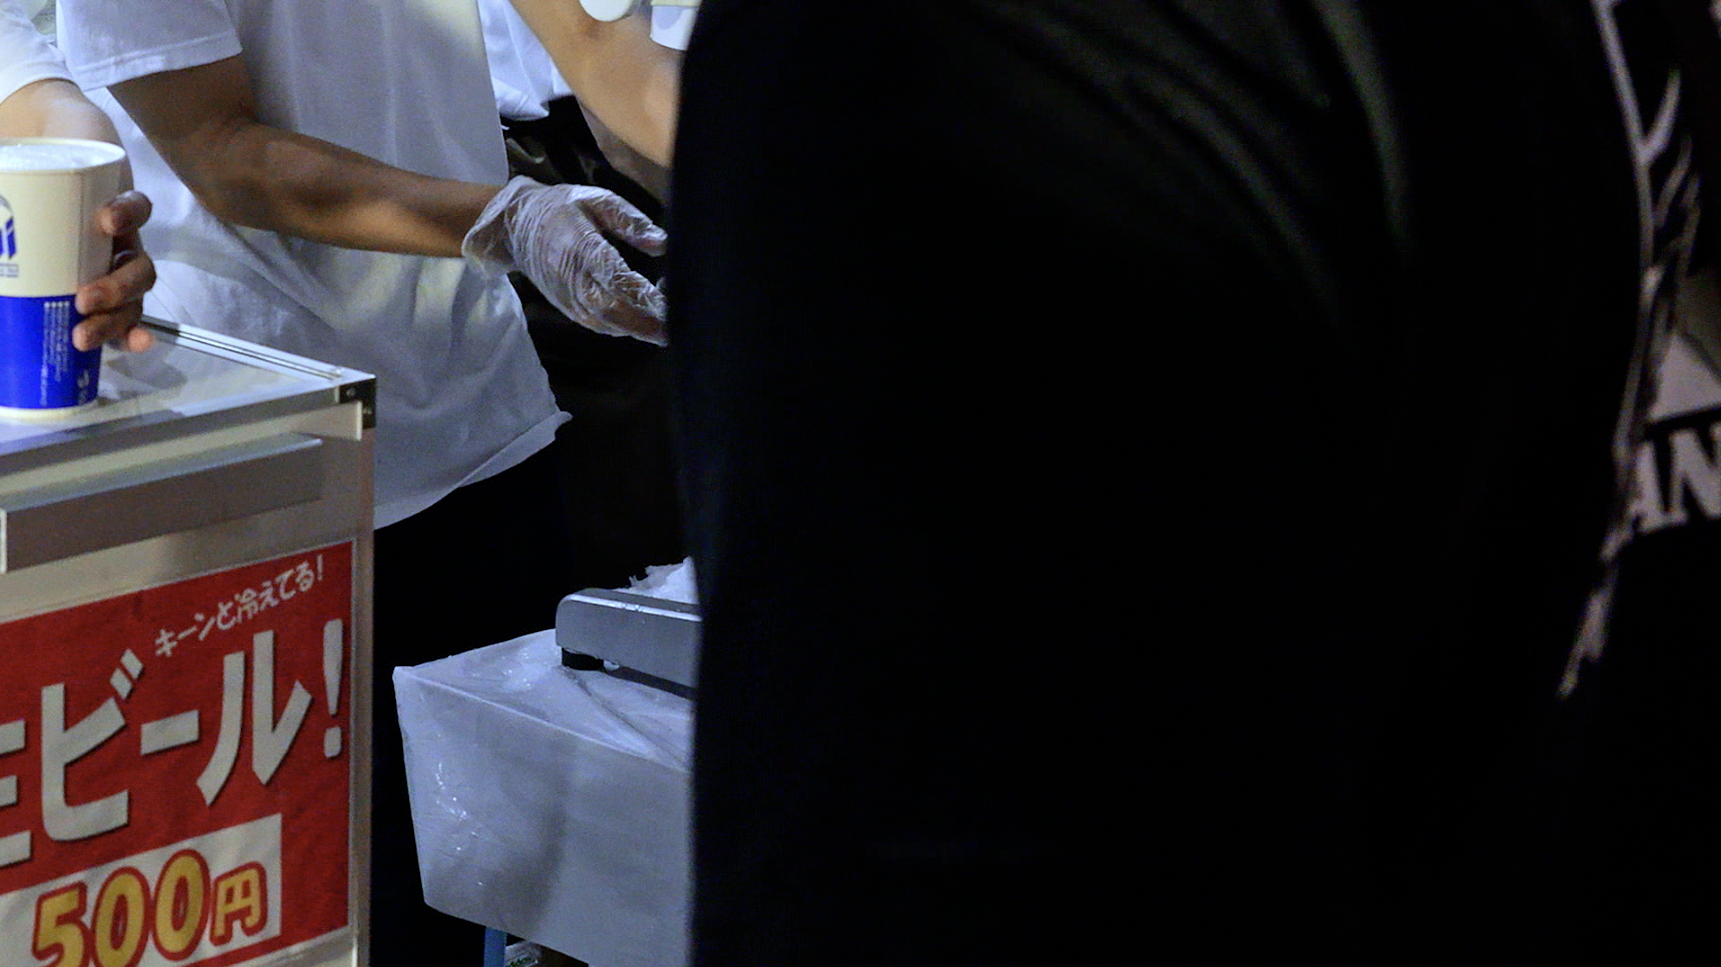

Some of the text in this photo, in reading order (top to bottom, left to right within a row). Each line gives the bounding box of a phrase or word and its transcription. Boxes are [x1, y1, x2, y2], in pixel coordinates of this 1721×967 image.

[155, 554, 324, 658] キーンと冷えてる!
[32, 848, 267, 967] 500円
